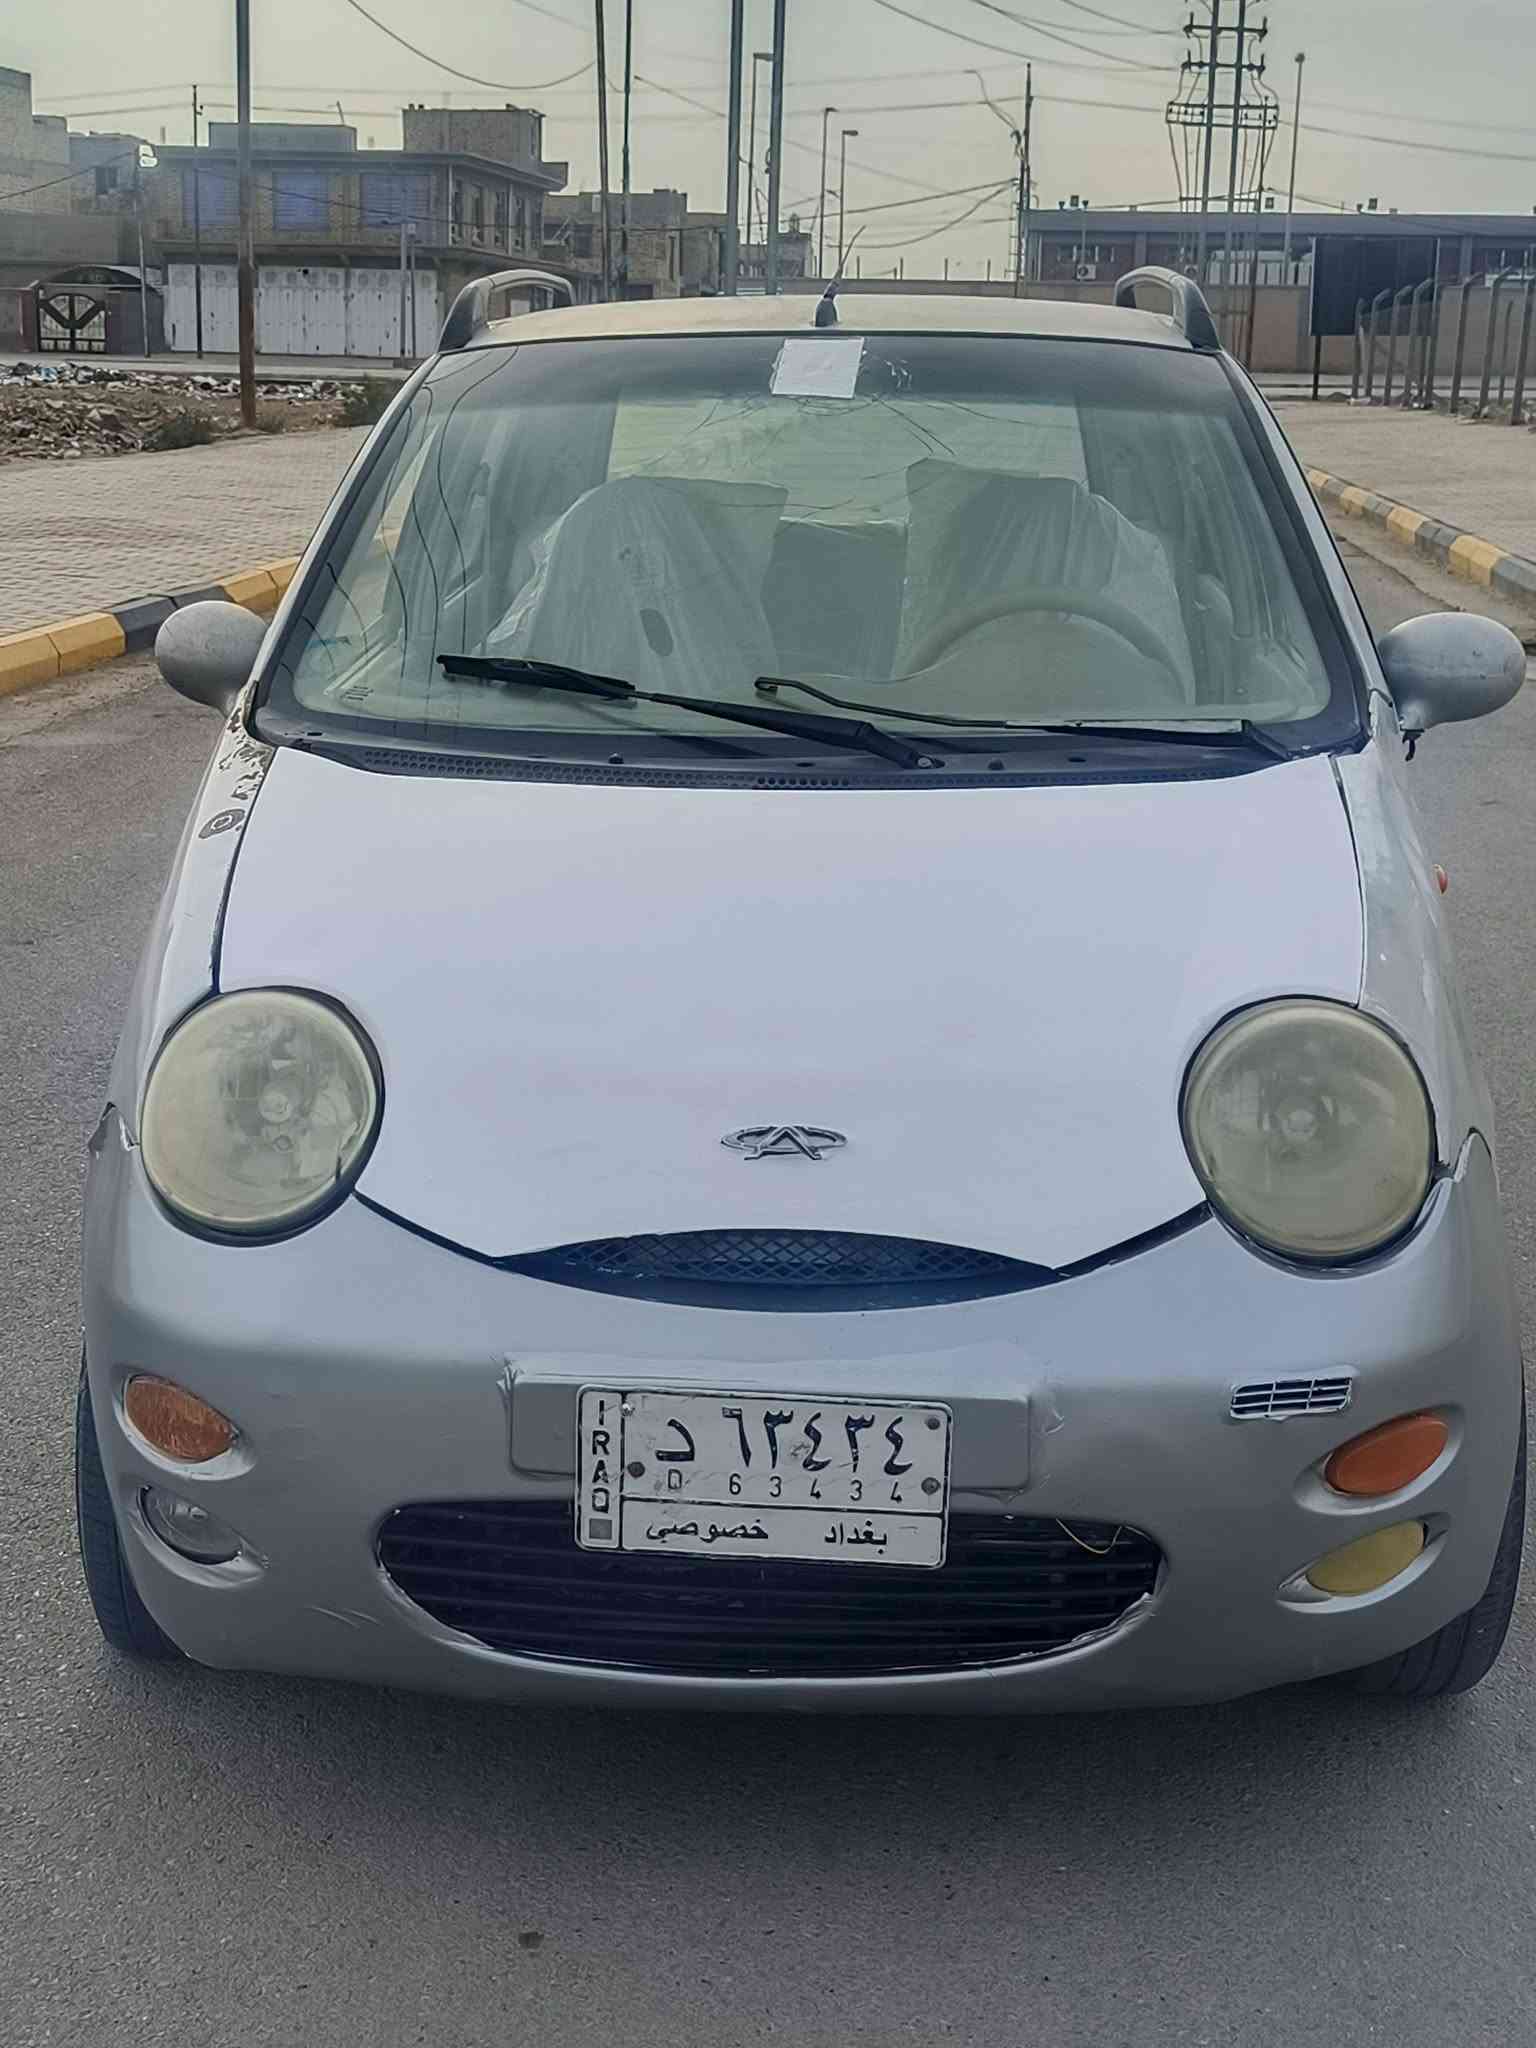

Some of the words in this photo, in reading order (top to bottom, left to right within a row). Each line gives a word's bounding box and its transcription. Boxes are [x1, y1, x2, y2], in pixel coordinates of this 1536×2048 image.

[591, 1399, 611, 1514] IRAQ
[721, 1406, 913, 1475] ٦٣٤٣٤
[728, 1472, 903, 1503] 63434
[646, 1518, 769, 1543] خصوصي
[824, 1520, 888, 1555] بغداد
